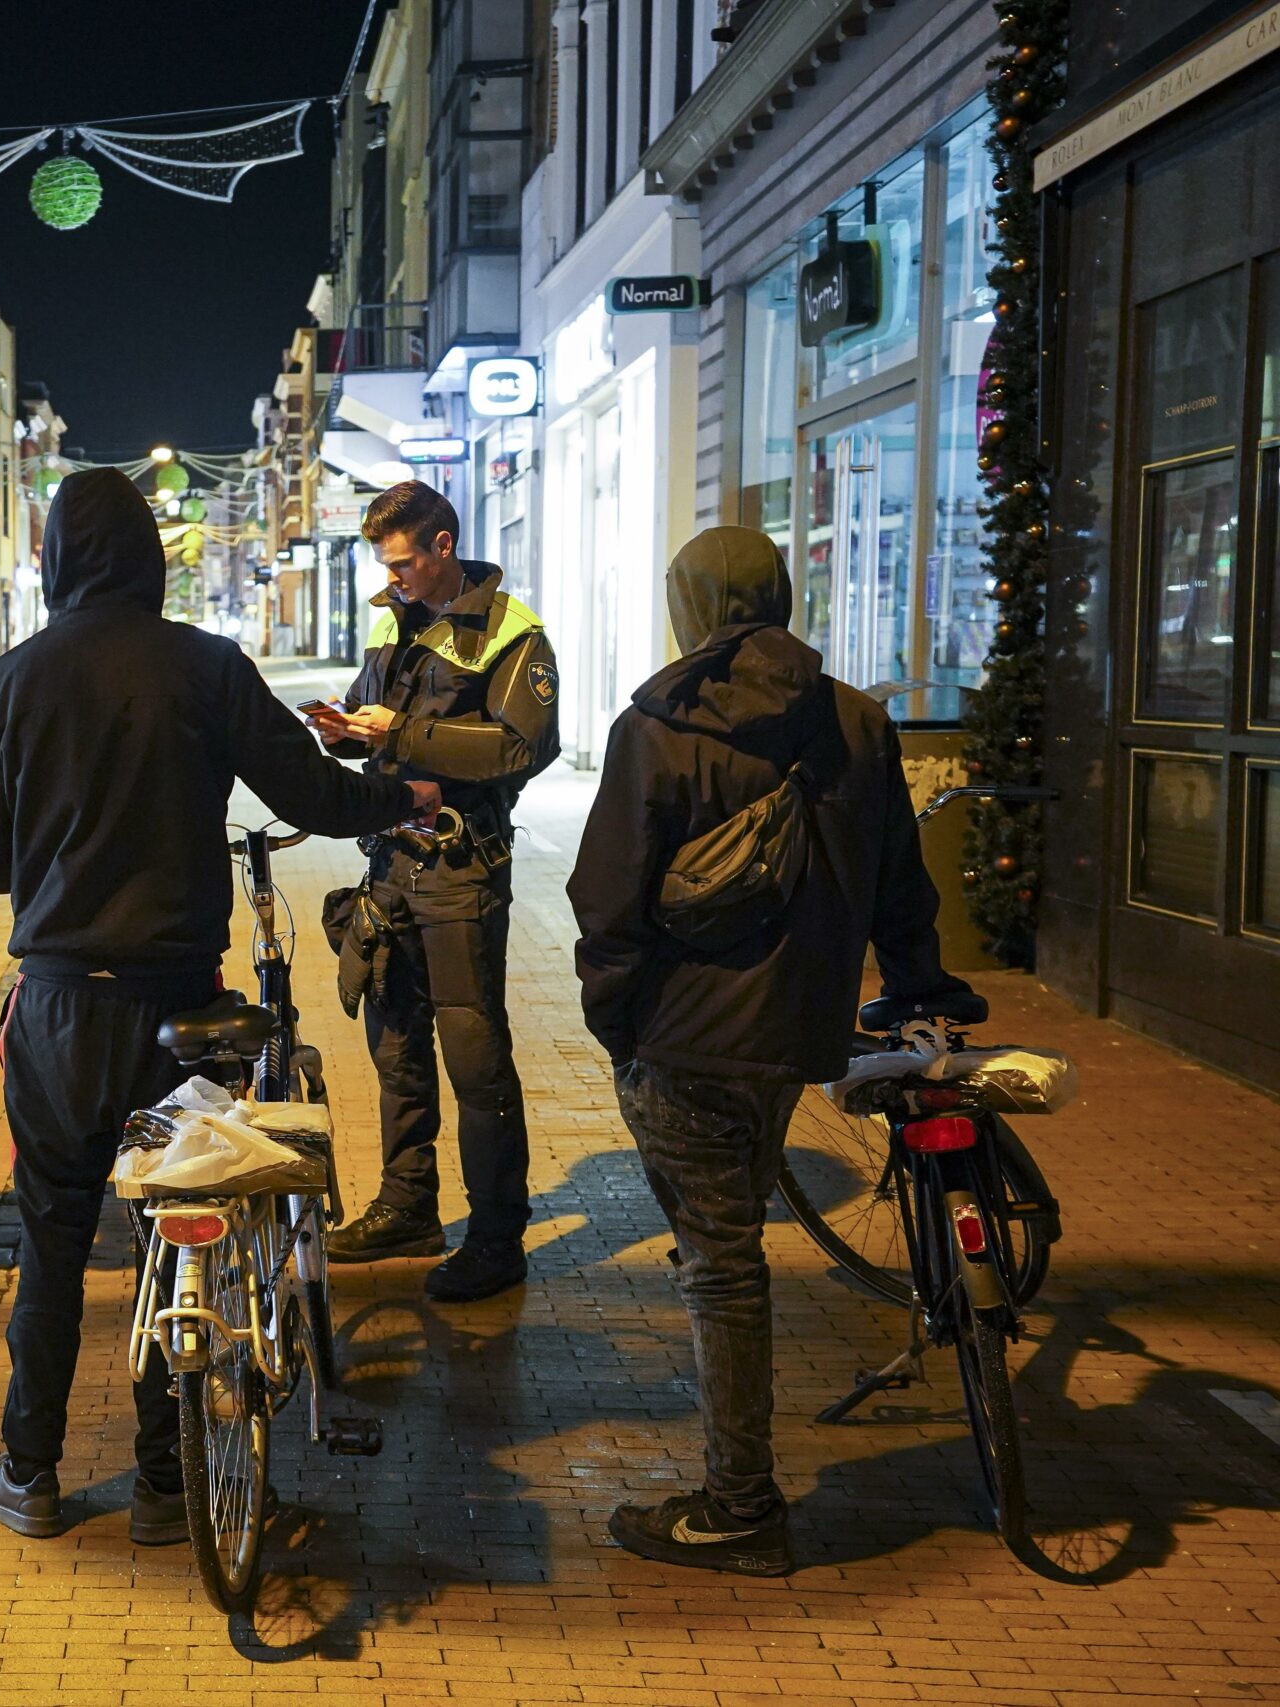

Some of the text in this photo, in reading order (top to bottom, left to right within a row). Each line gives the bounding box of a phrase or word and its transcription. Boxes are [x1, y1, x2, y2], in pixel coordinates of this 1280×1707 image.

[1118, 58, 1203, 125] MONT BLANC
[621, 283, 685, 304] Normal
[804, 261, 843, 323] Normal
